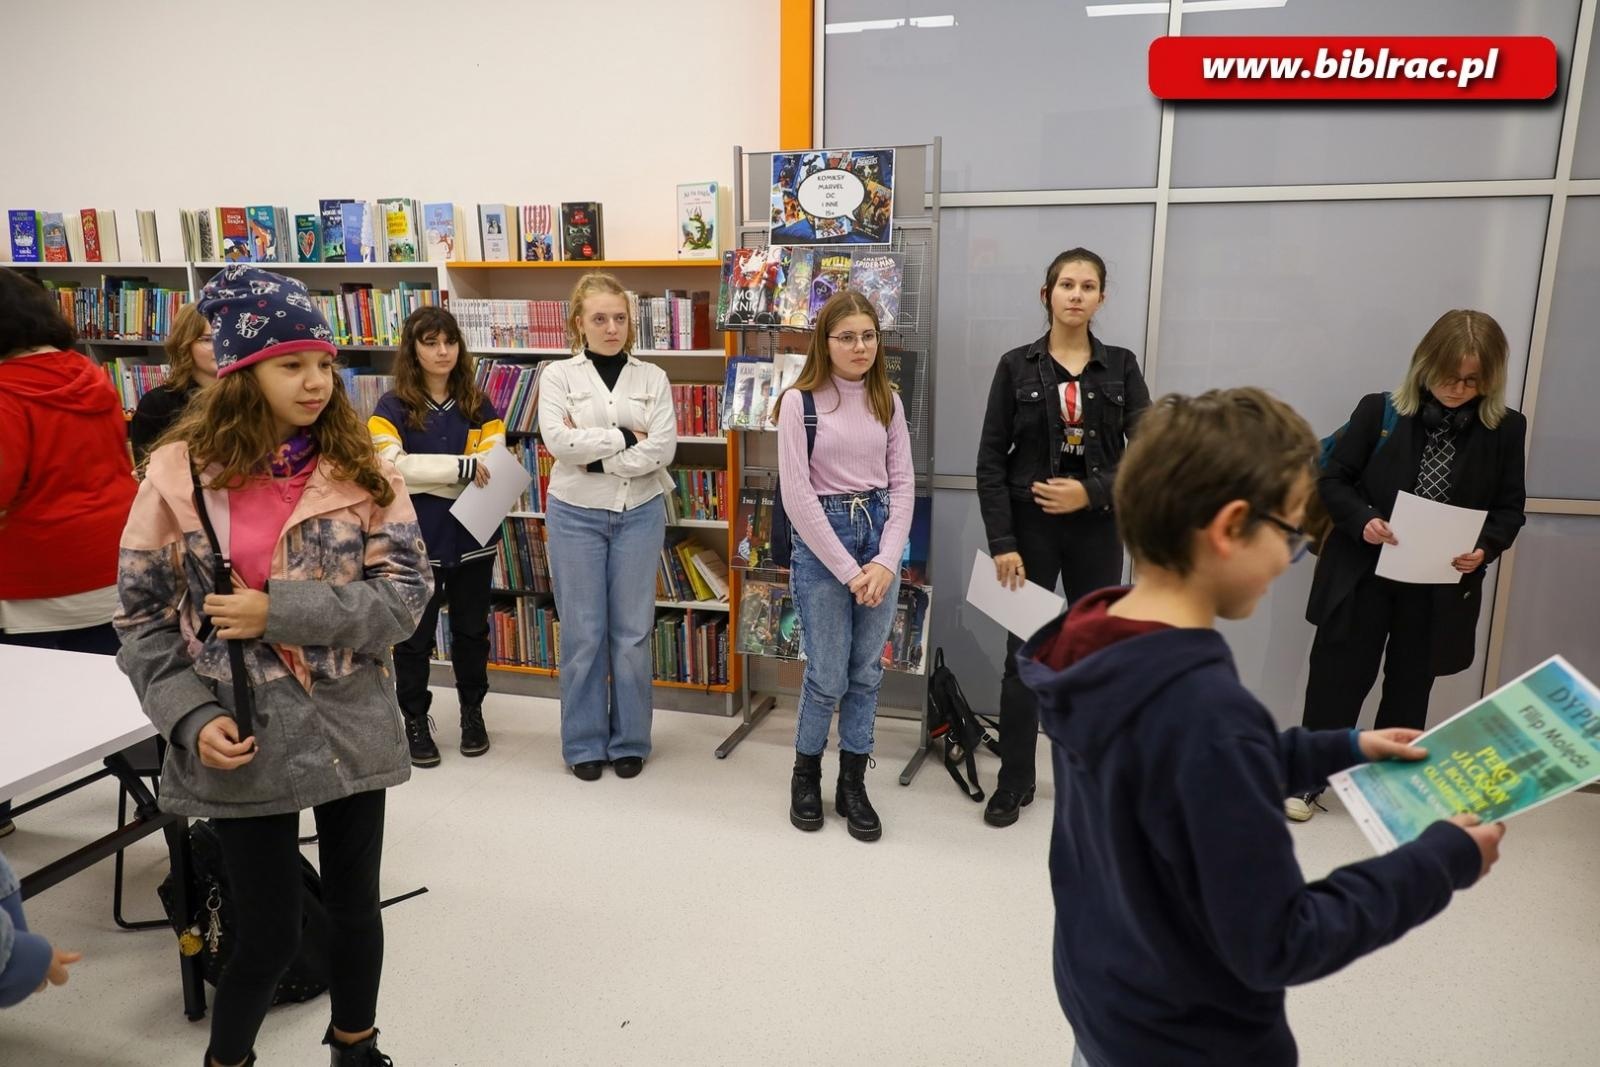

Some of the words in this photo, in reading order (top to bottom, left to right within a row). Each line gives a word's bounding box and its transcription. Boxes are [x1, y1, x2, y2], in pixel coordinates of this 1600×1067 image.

[854, 257, 896, 269] SPIDER-MAN
[1519, 704, 1546, 730] Filip
[1451, 750, 1510, 805] JACKSON
